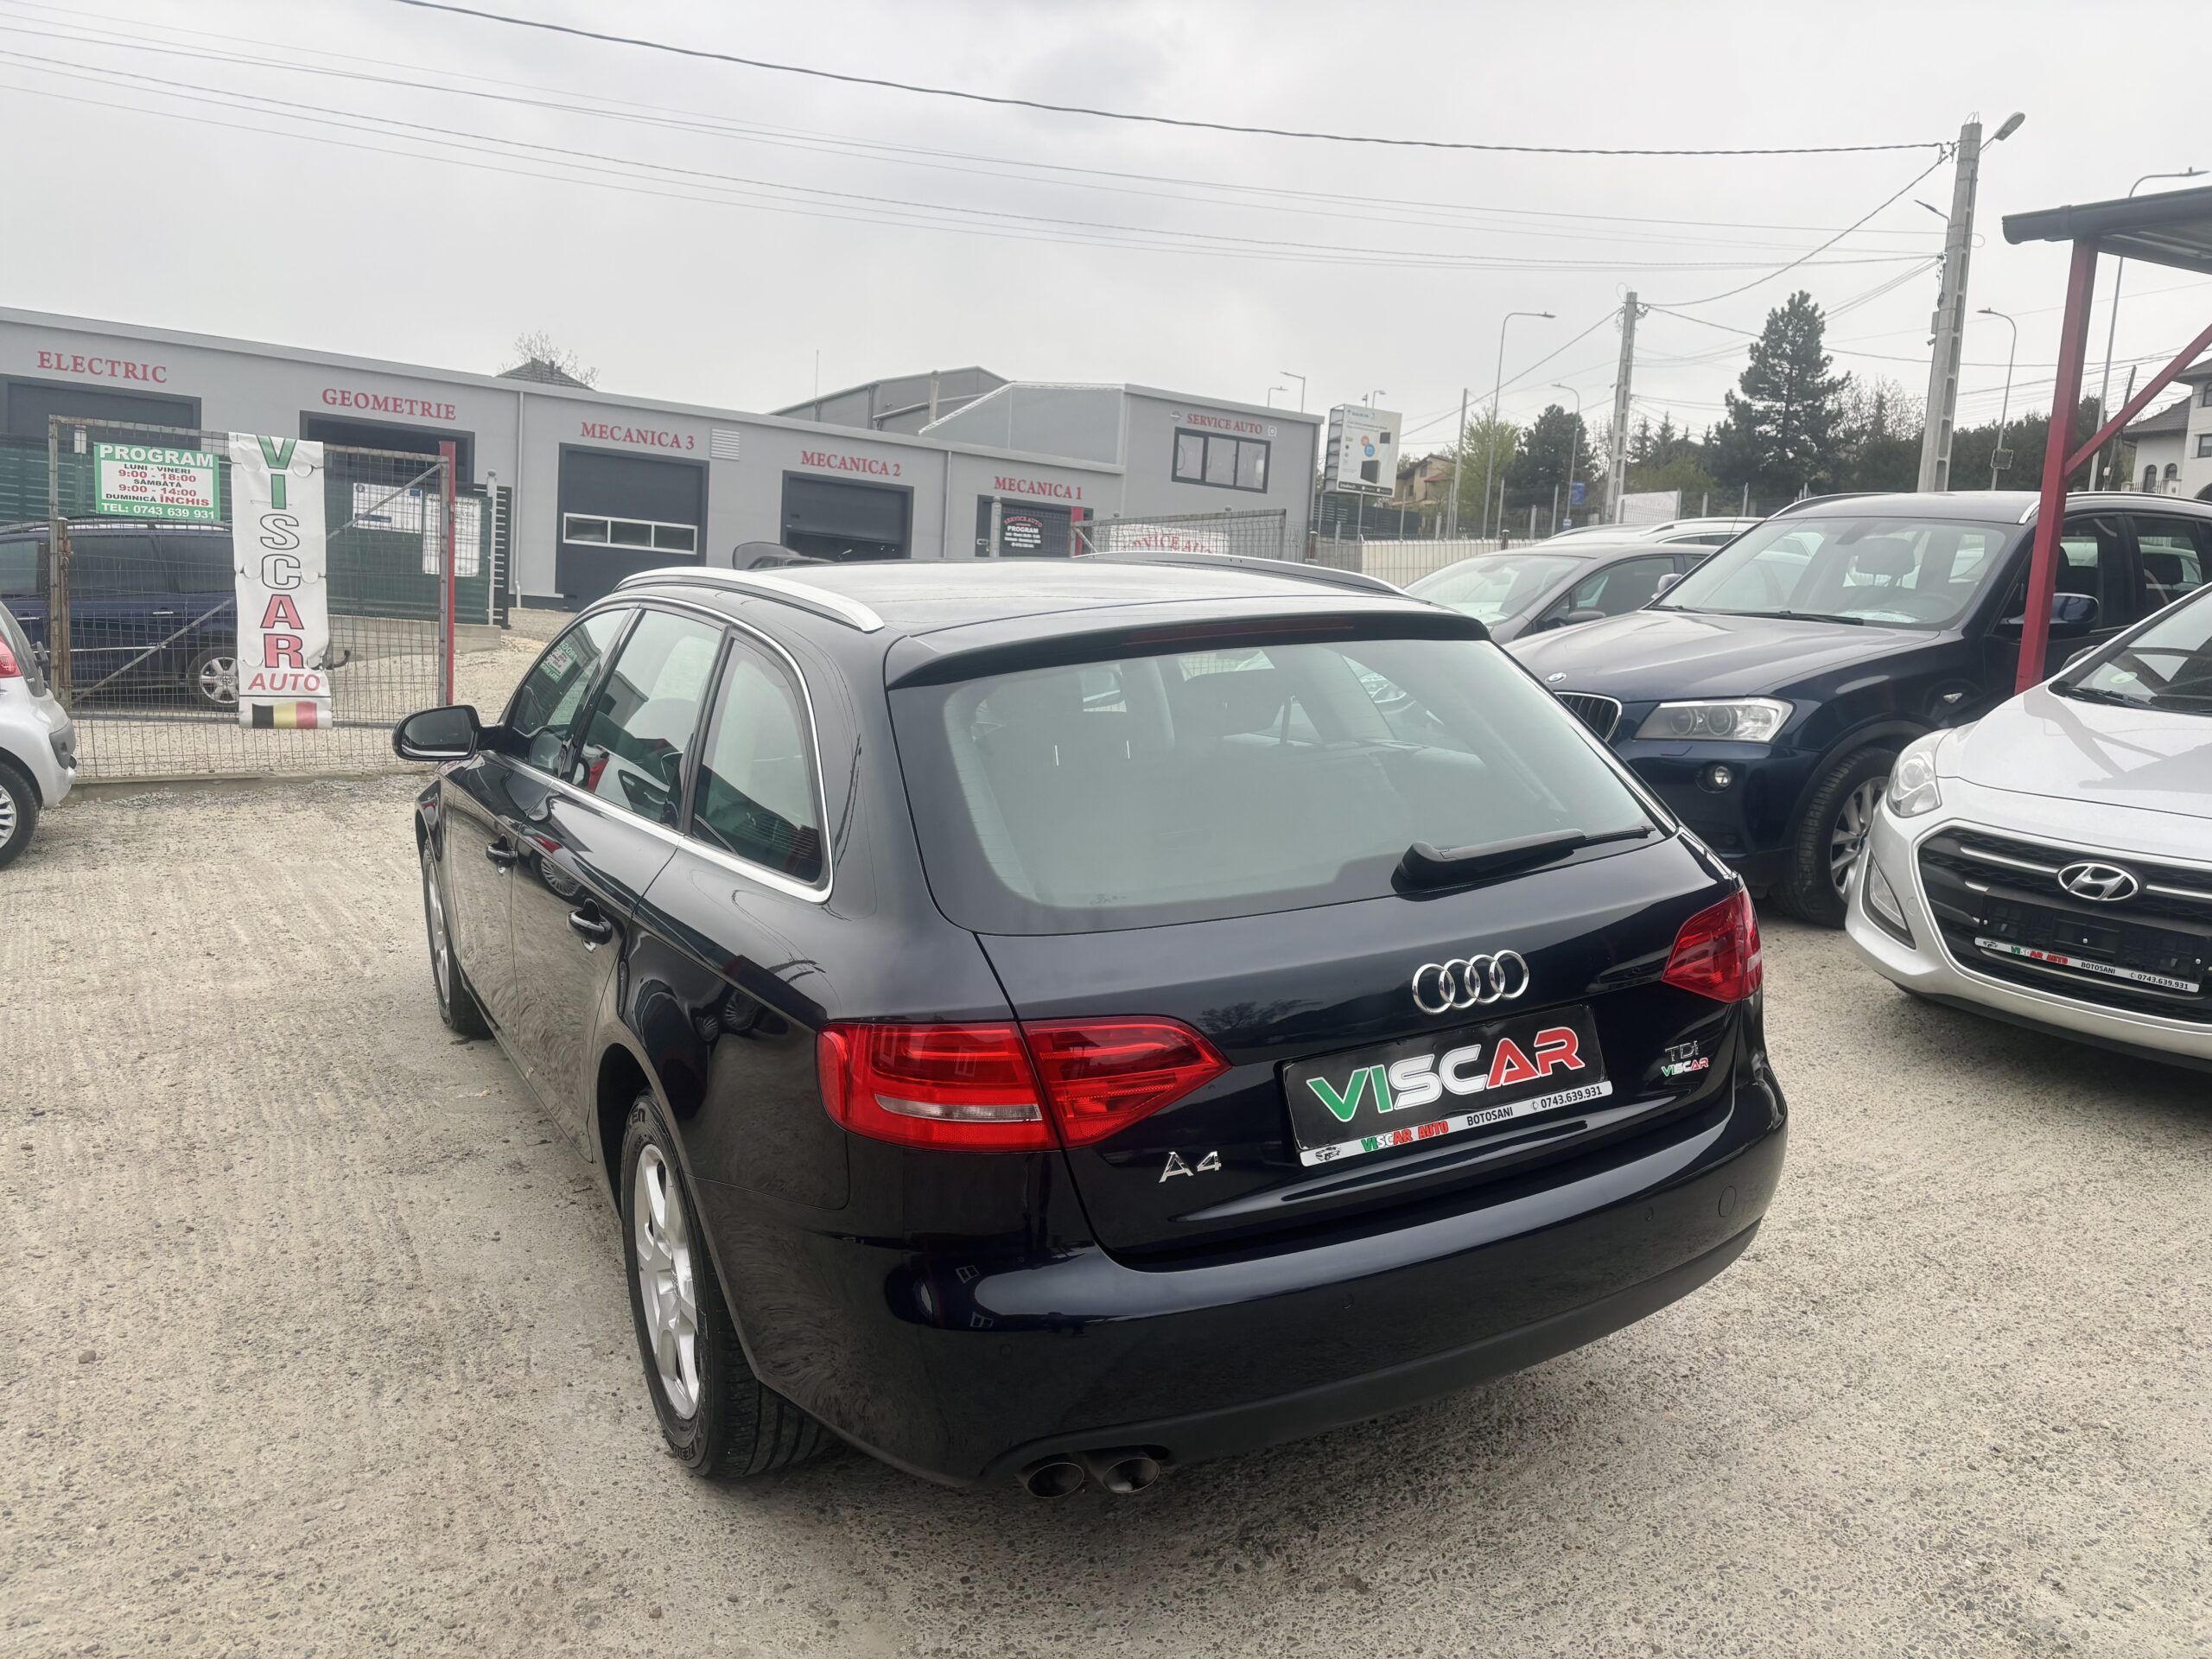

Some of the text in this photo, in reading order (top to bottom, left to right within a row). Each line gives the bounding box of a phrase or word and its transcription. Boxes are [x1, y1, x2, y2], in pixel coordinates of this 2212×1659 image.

[36, 350, 167, 384] ELECTRIC
[321, 388, 456, 420] GEOMETRIE
[580, 422, 695, 450] MECANICA 3
[1186, 413, 1262, 435] SERVICE AUTO
[99, 444, 213, 467] PROGRAM
[801, 450, 900, 477] MECANICA 2
[118, 470, 148, 479] 9:00
[160, 473, 196, 483] 18:00
[994, 476, 1082, 499] MECANICA 1
[118, 484, 148, 493] 9:00
[160, 487, 197, 497] 14:00
[101, 502, 214, 519] TEL: 0743 639 931
[248, 672, 321, 692] AUTO
[2081, 961, 2116, 975] BOTOSANI
[2137, 973, 2189, 990] 0743.639.931
[1306, 1027, 1585, 1122] VISCAR
[1661, 1057, 1709, 1077] VISCAR
[1360, 1085, 1603, 1152] VISCAR AUTO BOTOSANI 0743.639.931
[1159, 1151, 1222, 1183] A4
